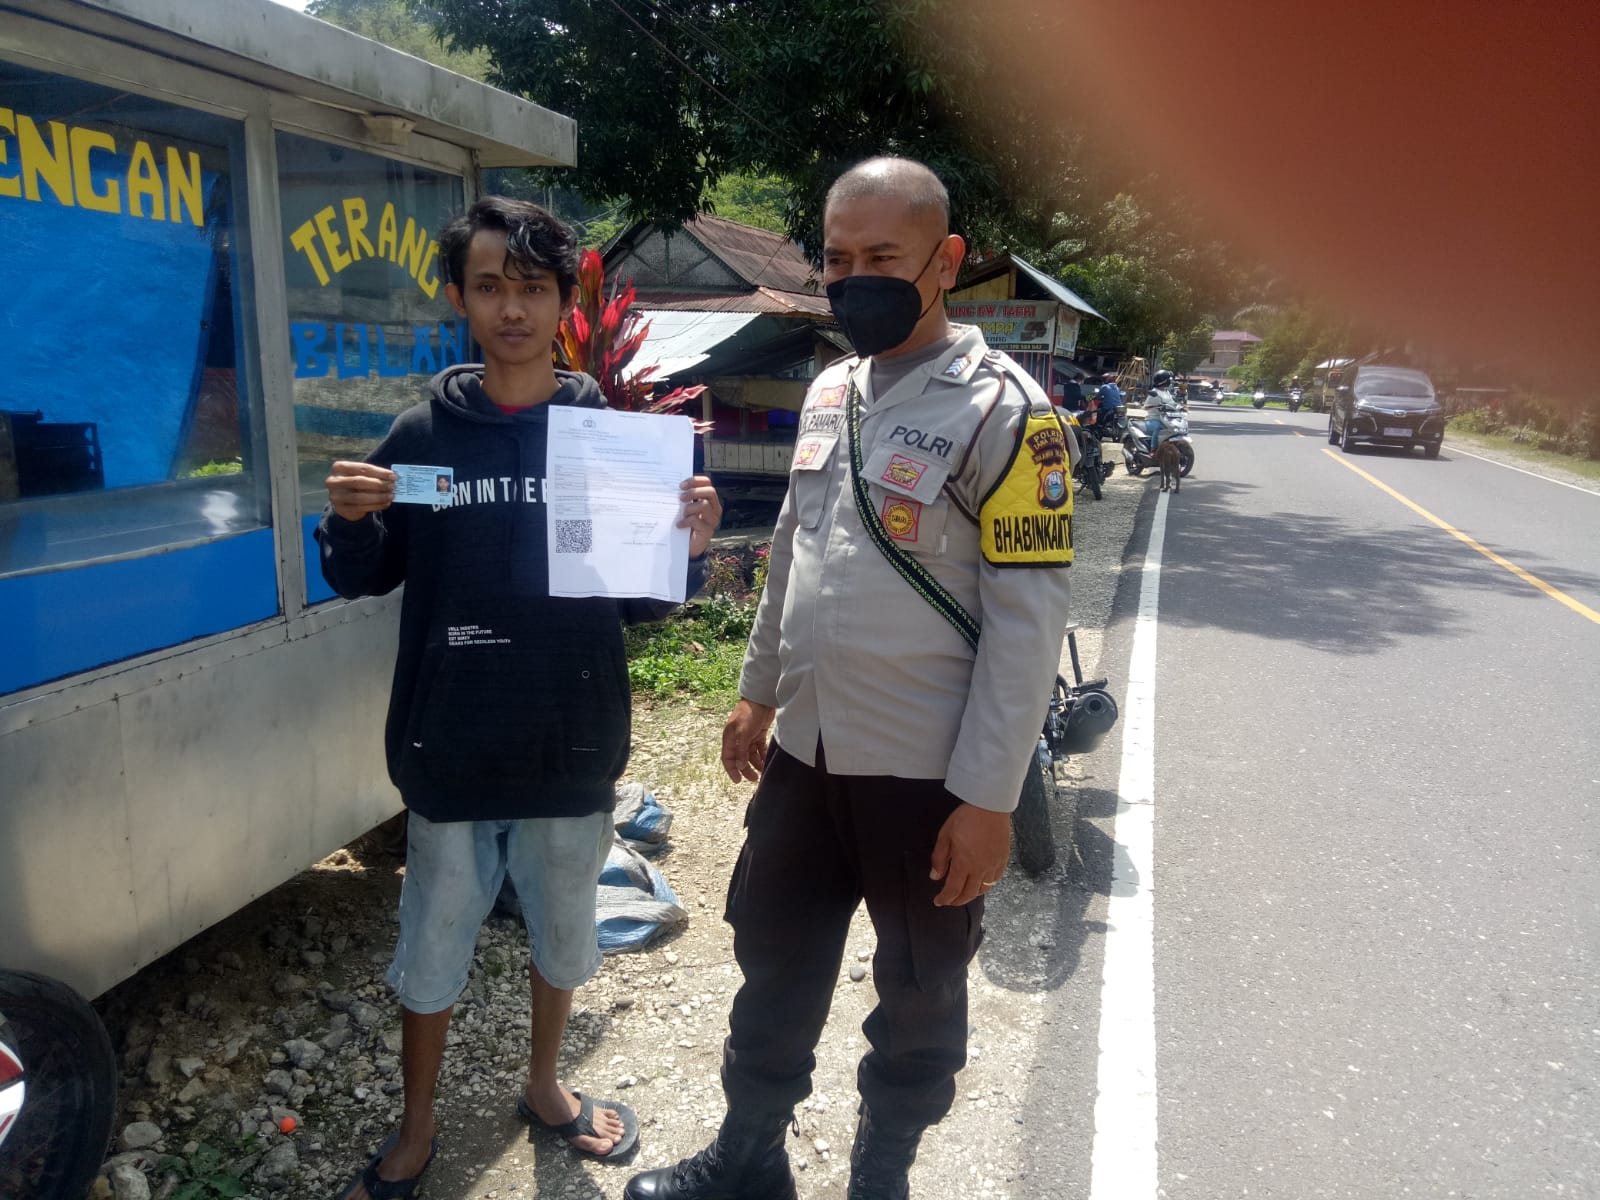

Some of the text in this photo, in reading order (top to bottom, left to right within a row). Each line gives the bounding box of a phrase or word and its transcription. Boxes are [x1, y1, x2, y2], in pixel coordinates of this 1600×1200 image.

[289, 197, 440, 299] TERANG
[290, 322, 464, 380] BULAN
[889, 425, 954, 459] POLRI
[476, 478, 496, 504] IN
